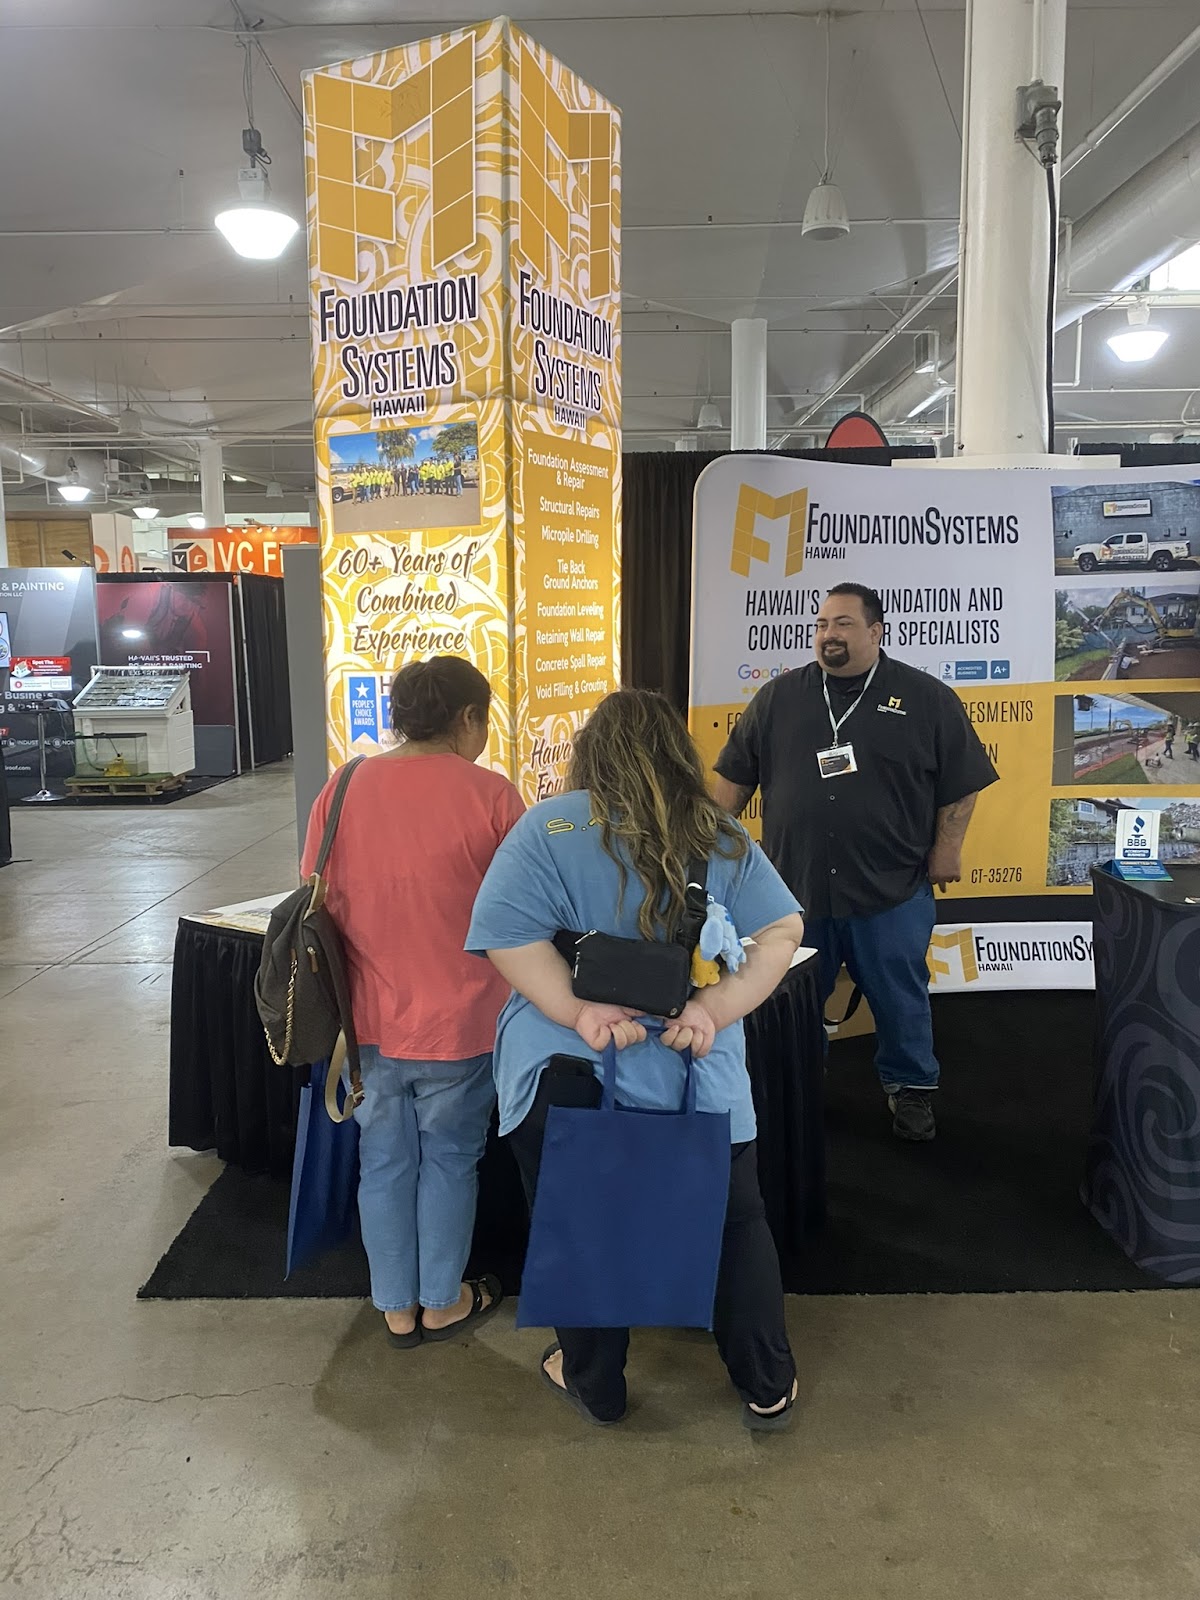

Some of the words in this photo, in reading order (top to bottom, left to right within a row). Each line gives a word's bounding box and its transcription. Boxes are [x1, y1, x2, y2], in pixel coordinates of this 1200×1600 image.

[319, 275, 478, 342] FOUNDATION
[519, 271, 612, 360] FOUNDATION
[342, 342, 456, 398] SYSTEMS
[535, 341, 602, 411] SYSTEMS
[373, 395, 425, 417] HAWAII
[554, 406, 586, 428] HAWAII
[528, 448, 568, 470] Foundation
[570, 457, 609, 479] Assessment
[556, 470, 562, 485] &
[563, 471, 586, 492] Repair
[540, 496, 575, 516] Structural
[576, 501, 600, 521] Repairs
[541, 525, 575, 546] Micropile
[576, 528, 599, 549] Drilling
[217, 541, 254, 573] VC
[338, 547, 382, 577] 60+
[390, 546, 445, 574] Years
[451, 541, 478, 580] of
[805, 547, 846, 559] HAWAII
[557, 559, 569, 573] Tie
[570, 559, 586, 574] Back
[1, 583, 9, 591] &
[12, 582, 65, 591] PAINTING
[543, 573, 570, 589] Ground
[571, 575, 599, 590] Anchors
[357, 582, 458, 614] Combined
[745, 588, 820, 616] HAWAII'S
[873, 588, 961, 613] UNDATION
[968, 586, 1003, 612] AND
[537, 601, 576, 617] Foundation
[577, 601, 604, 620] Leveling
[354, 625, 466, 661] Experience
[536, 629, 569, 647] Retaining
[570, 628, 584, 642] Wall
[586, 627, 606, 645] Repair
[898, 619, 1000, 646] SPECIALISTS
[535, 657, 569, 672] Concrete
[570, 654, 586, 672] Spall
[587, 652, 607, 670] Repair
[994, 665, 1007, 674] A+
[536, 683, 552, 699] Void
[554, 682, 574, 699] Filling
[574, 680, 580, 694] &
[580, 678, 608, 694] Grouting
[8, 703, 16, 711] &
[352, 700, 375, 708] PEOPLE'S
[354, 709, 373, 717] CHOICE
[353, 718, 375, 726] AWARDS
[531, 737, 572, 769] Hawa
[1127, 839, 1147, 847] BBB
[971, 867, 1022, 883] CT-35276
[975, 935, 1093, 962] FOUNDATIONSY
[978, 963, 1013, 972] HAWAII
